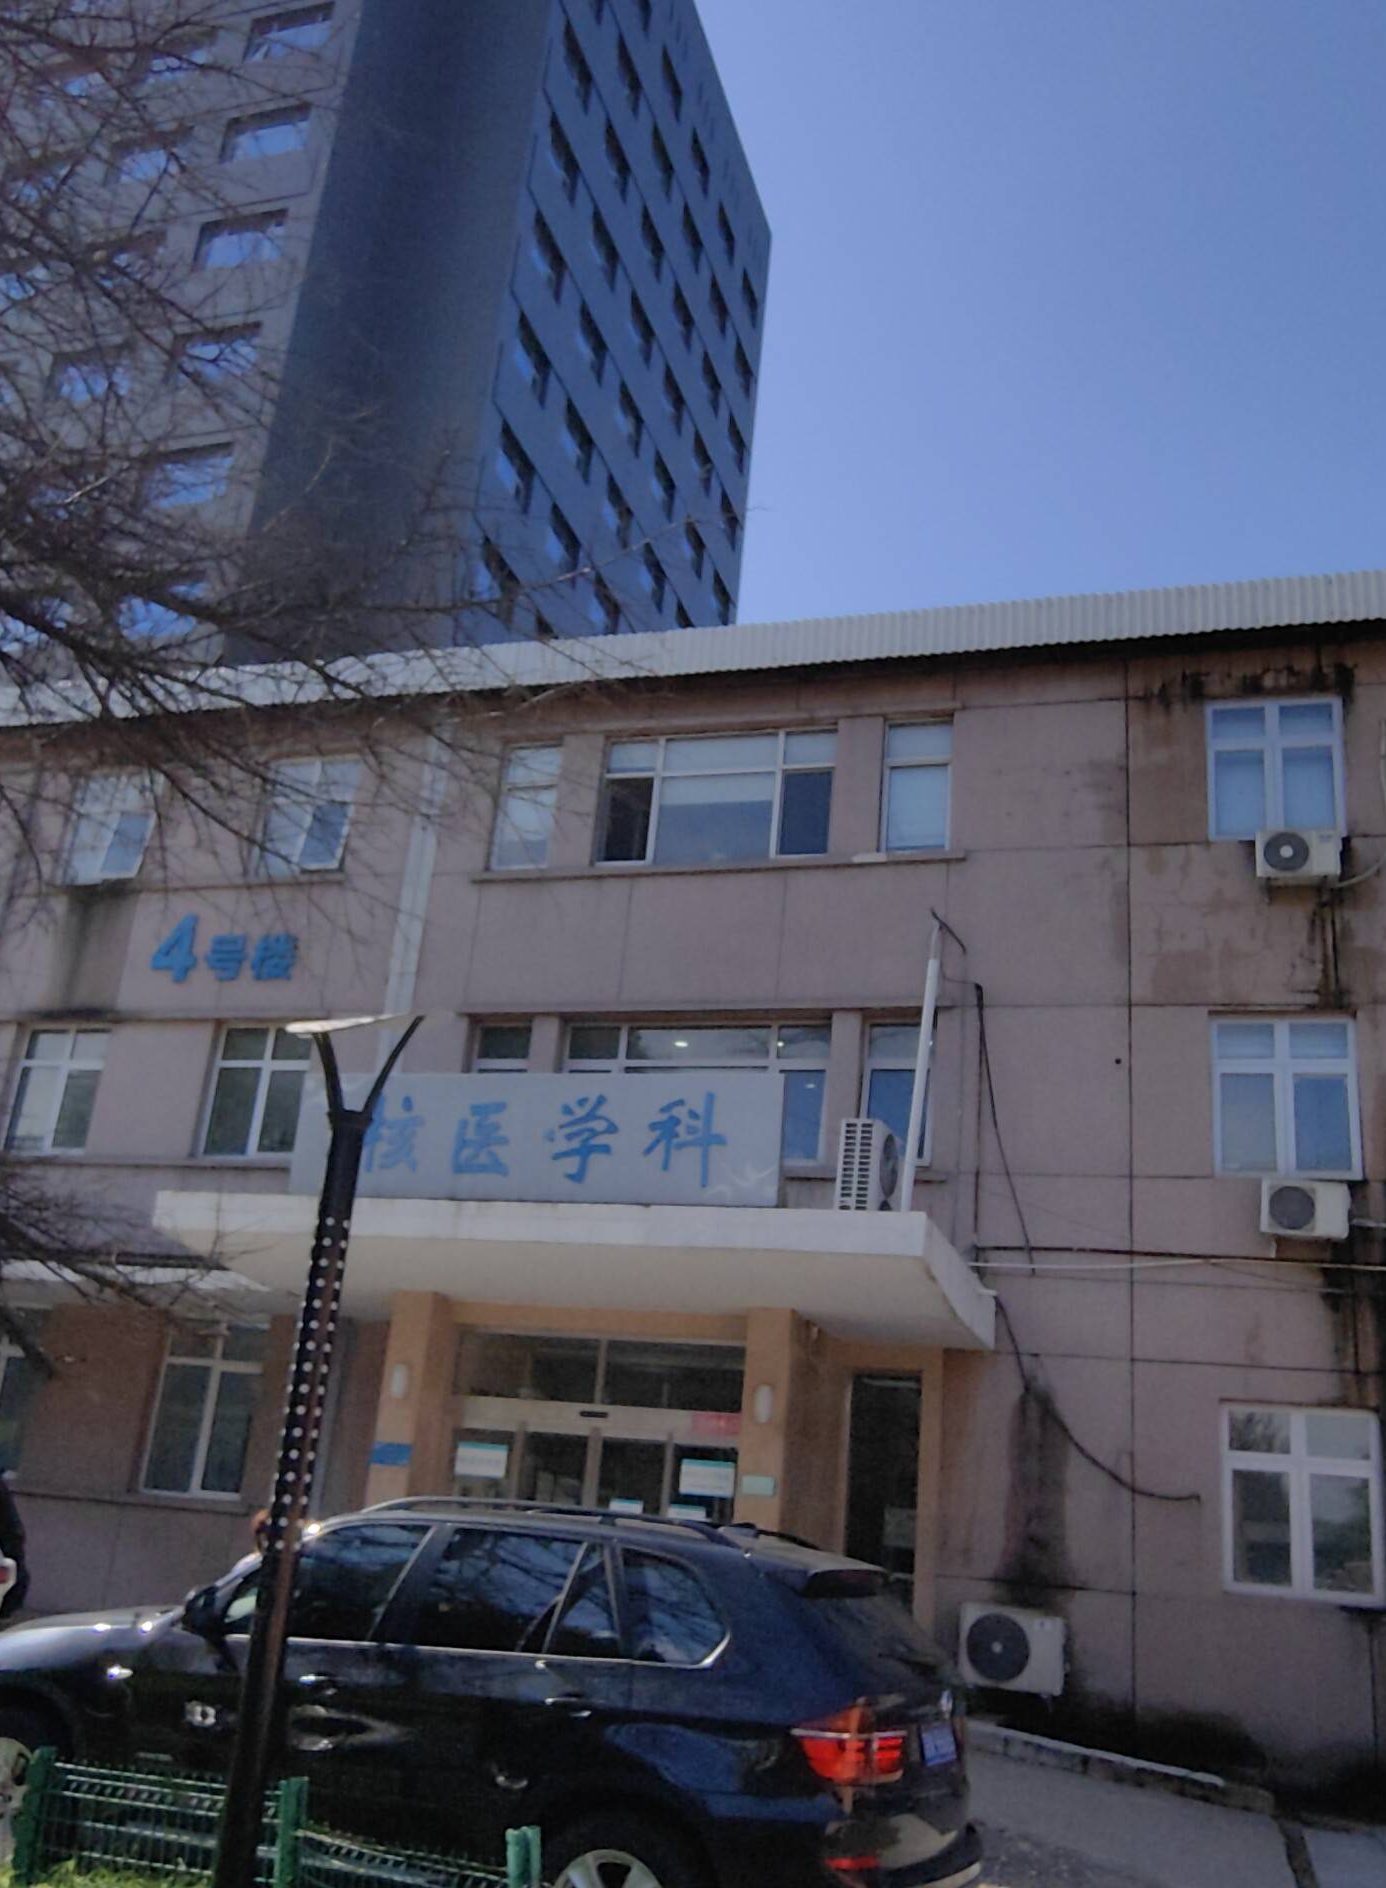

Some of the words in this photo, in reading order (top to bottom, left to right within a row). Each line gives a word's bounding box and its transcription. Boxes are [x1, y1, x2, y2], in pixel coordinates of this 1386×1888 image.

[149, 911, 299, 984] 4号楼
[362, 1091, 728, 1189] 核医学科
